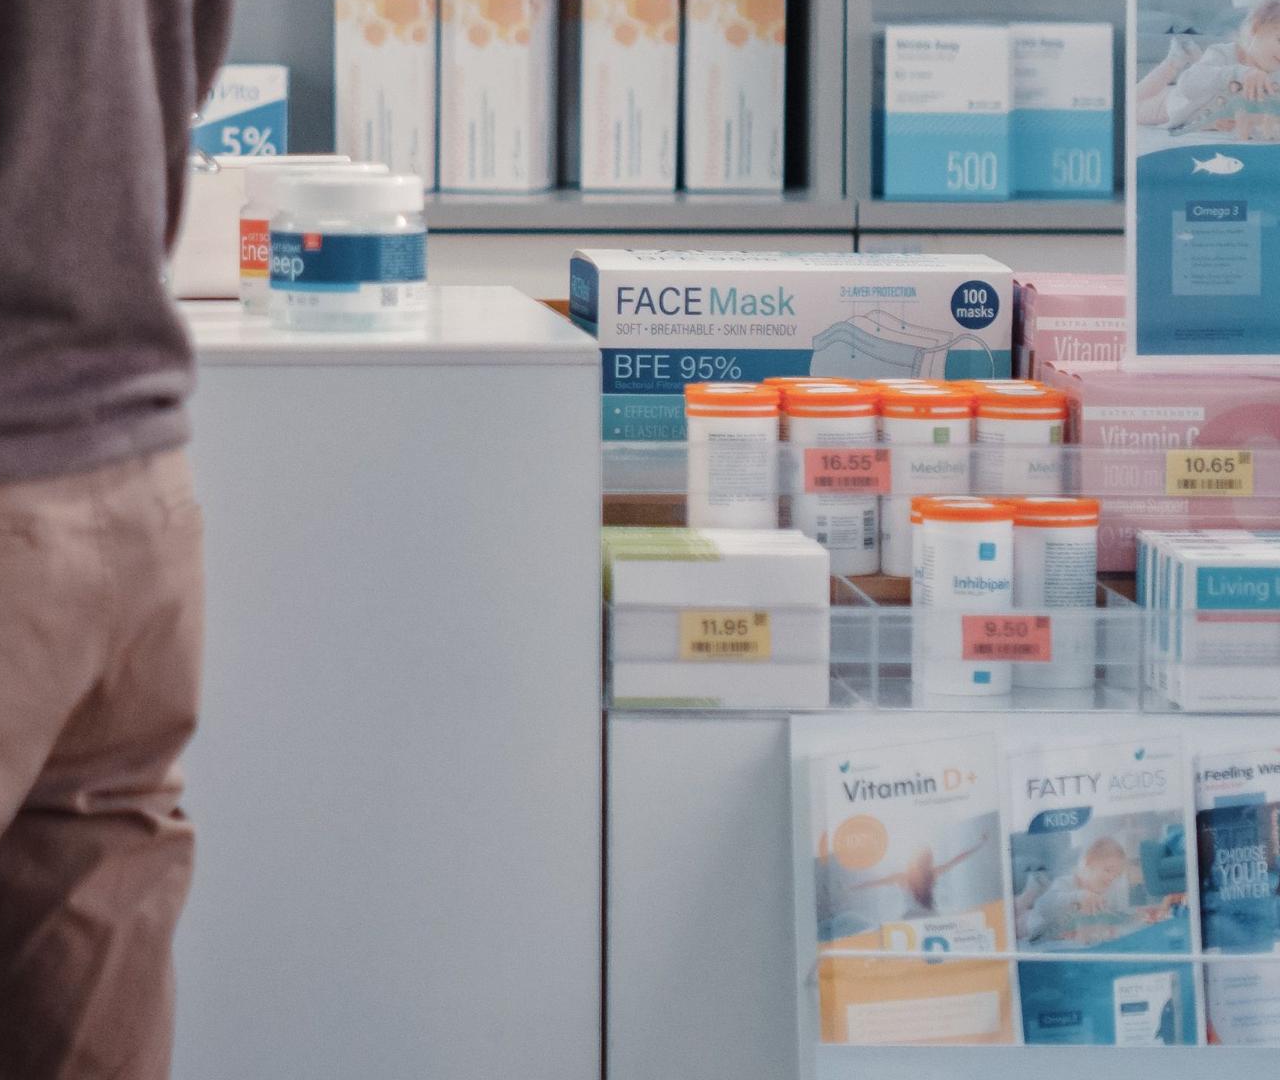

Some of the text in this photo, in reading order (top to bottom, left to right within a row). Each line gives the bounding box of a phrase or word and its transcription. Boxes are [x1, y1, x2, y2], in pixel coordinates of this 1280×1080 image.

[220, 127, 277, 156] 5%
[947, 150, 997, 190] 500
[1053, 148, 1102, 187] 500
[1193, 205, 1241, 219] Omega 3
[615, 283, 795, 316] FACE Mask
[872, 286, 917, 297] PROTECTION
[963, 288, 987, 305] 100
[956, 305, 994, 318] masks
[615, 322, 798, 337] SOFT BREATHABLE SKIN FRIENDLY
[613, 354, 742, 380] BFE 95%
[624, 406, 681, 419] EFFECTIVE
[624, 426, 668, 439] ELASTIC
[1099, 425, 1181, 450] Vitamin
[822, 456, 872, 472] 16.55
[1186, 457, 1236, 473] 10.65
[1207, 577, 1270, 602] Living
[701, 620, 749, 637] 11.95
[984, 622, 1029, 638] 9.50
[1203, 766, 1254, 781] Feeling
[842, 772, 937, 803] Vitamin
[1025, 769, 1168, 800] FATTY ACIDS
[1044, 813, 1079, 827] KIDS
[1218, 844, 1267, 864] CHOOSE
[1218, 861, 1269, 883] YOUR
[1219, 882, 1270, 902] WINTER
